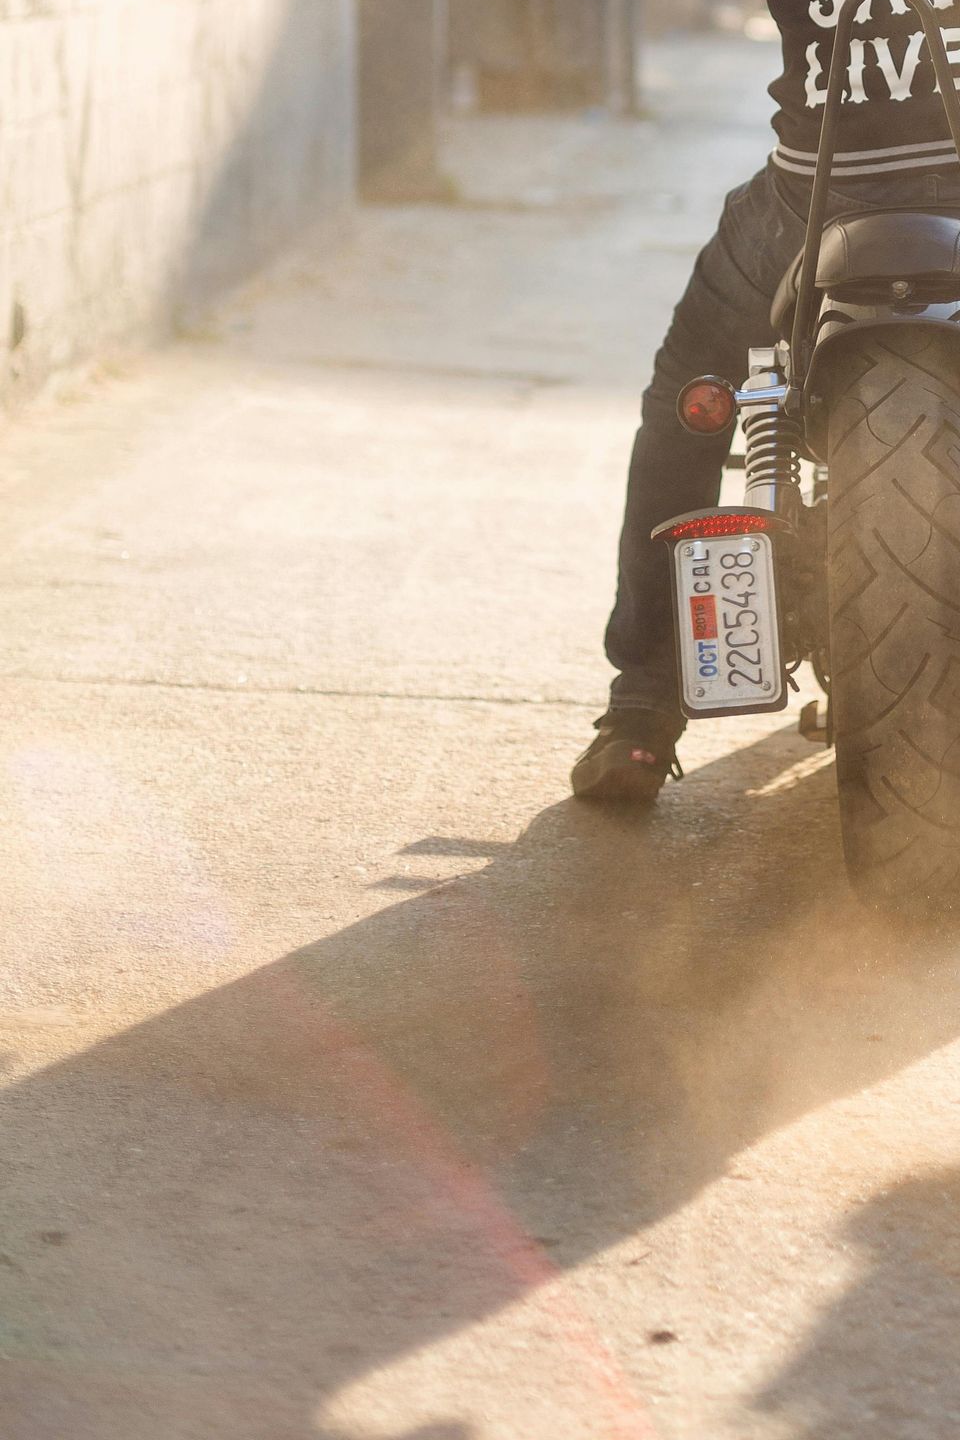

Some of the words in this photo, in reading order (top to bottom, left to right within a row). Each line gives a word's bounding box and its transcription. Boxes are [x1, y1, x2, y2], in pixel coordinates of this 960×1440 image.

[692, 549, 711, 594] CAL
[720, 552, 763, 687] 22C5438
[698, 642, 718, 678] OCT
